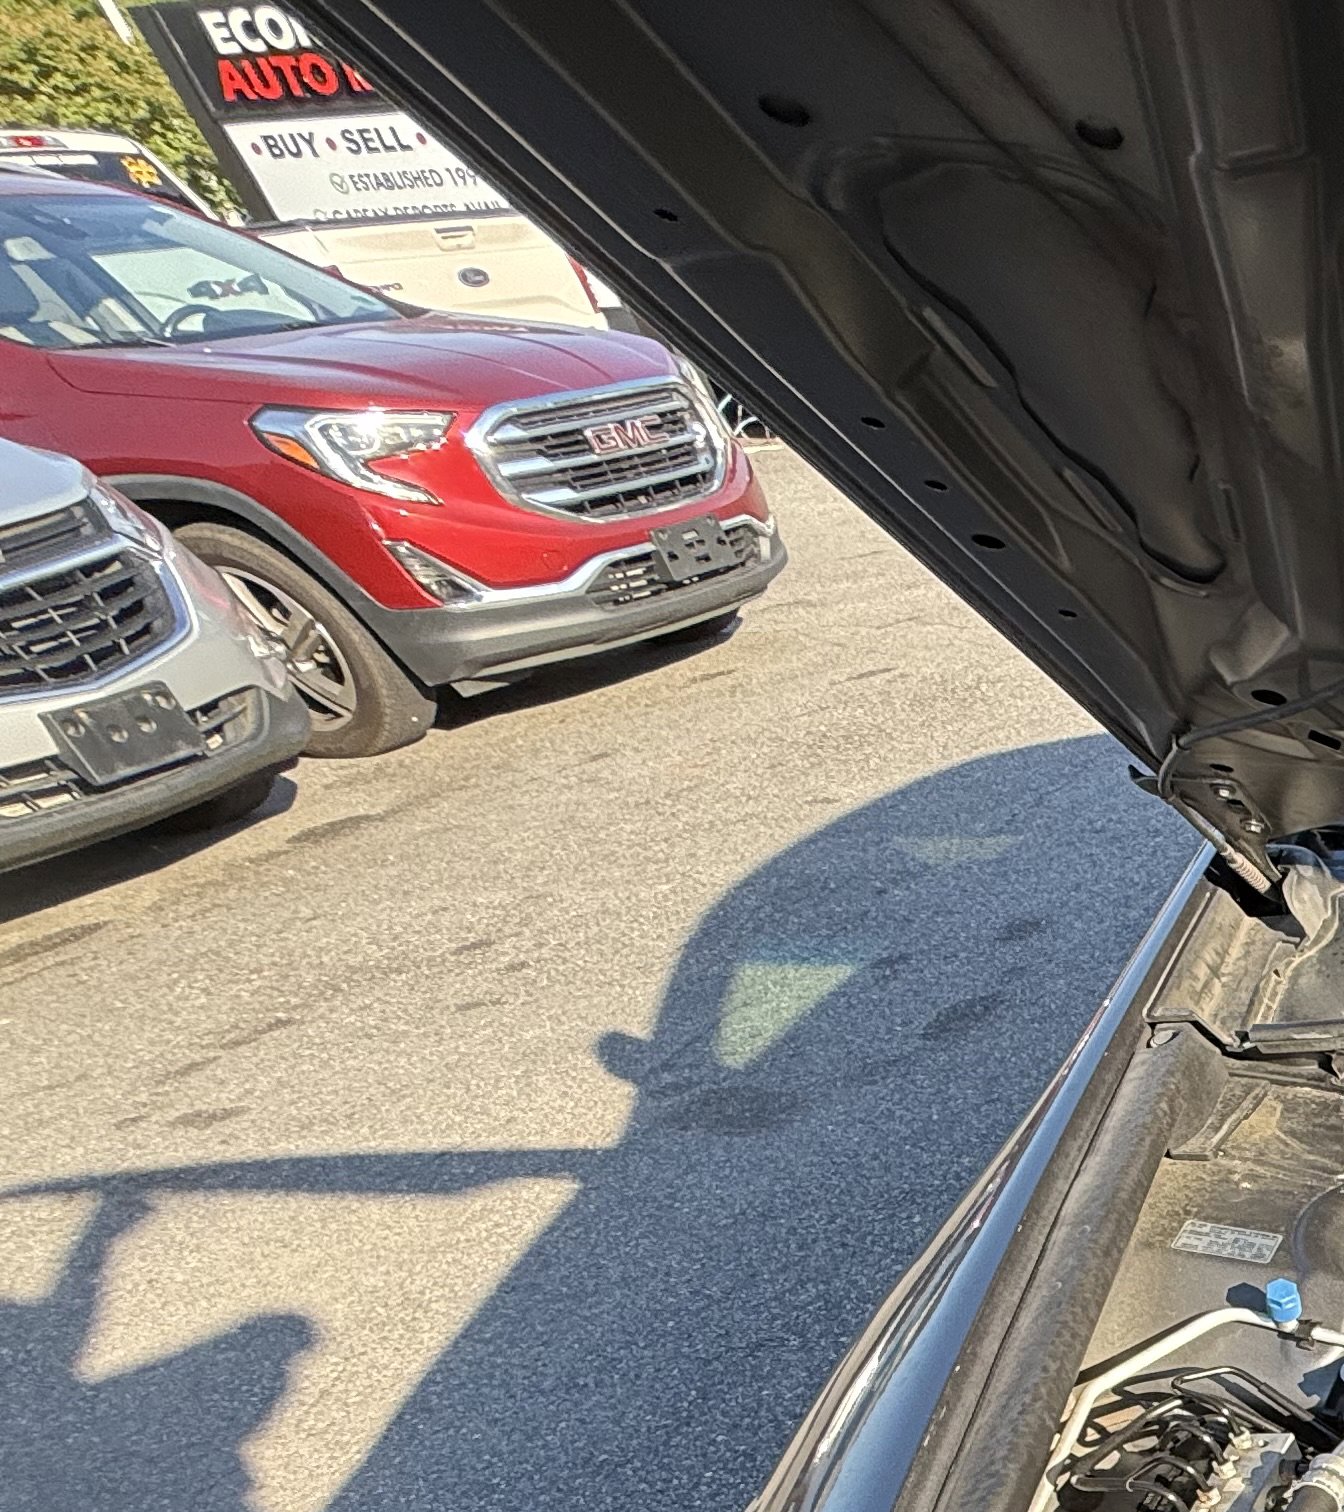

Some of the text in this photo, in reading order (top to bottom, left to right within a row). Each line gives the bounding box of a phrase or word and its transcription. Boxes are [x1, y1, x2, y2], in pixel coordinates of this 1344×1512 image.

[218, 52, 339, 102] AUTO
[261, 126, 414, 160] BUY SELL
[350, 168, 444, 192] ESTABLISHED
[583, 414, 671, 457] GMC
